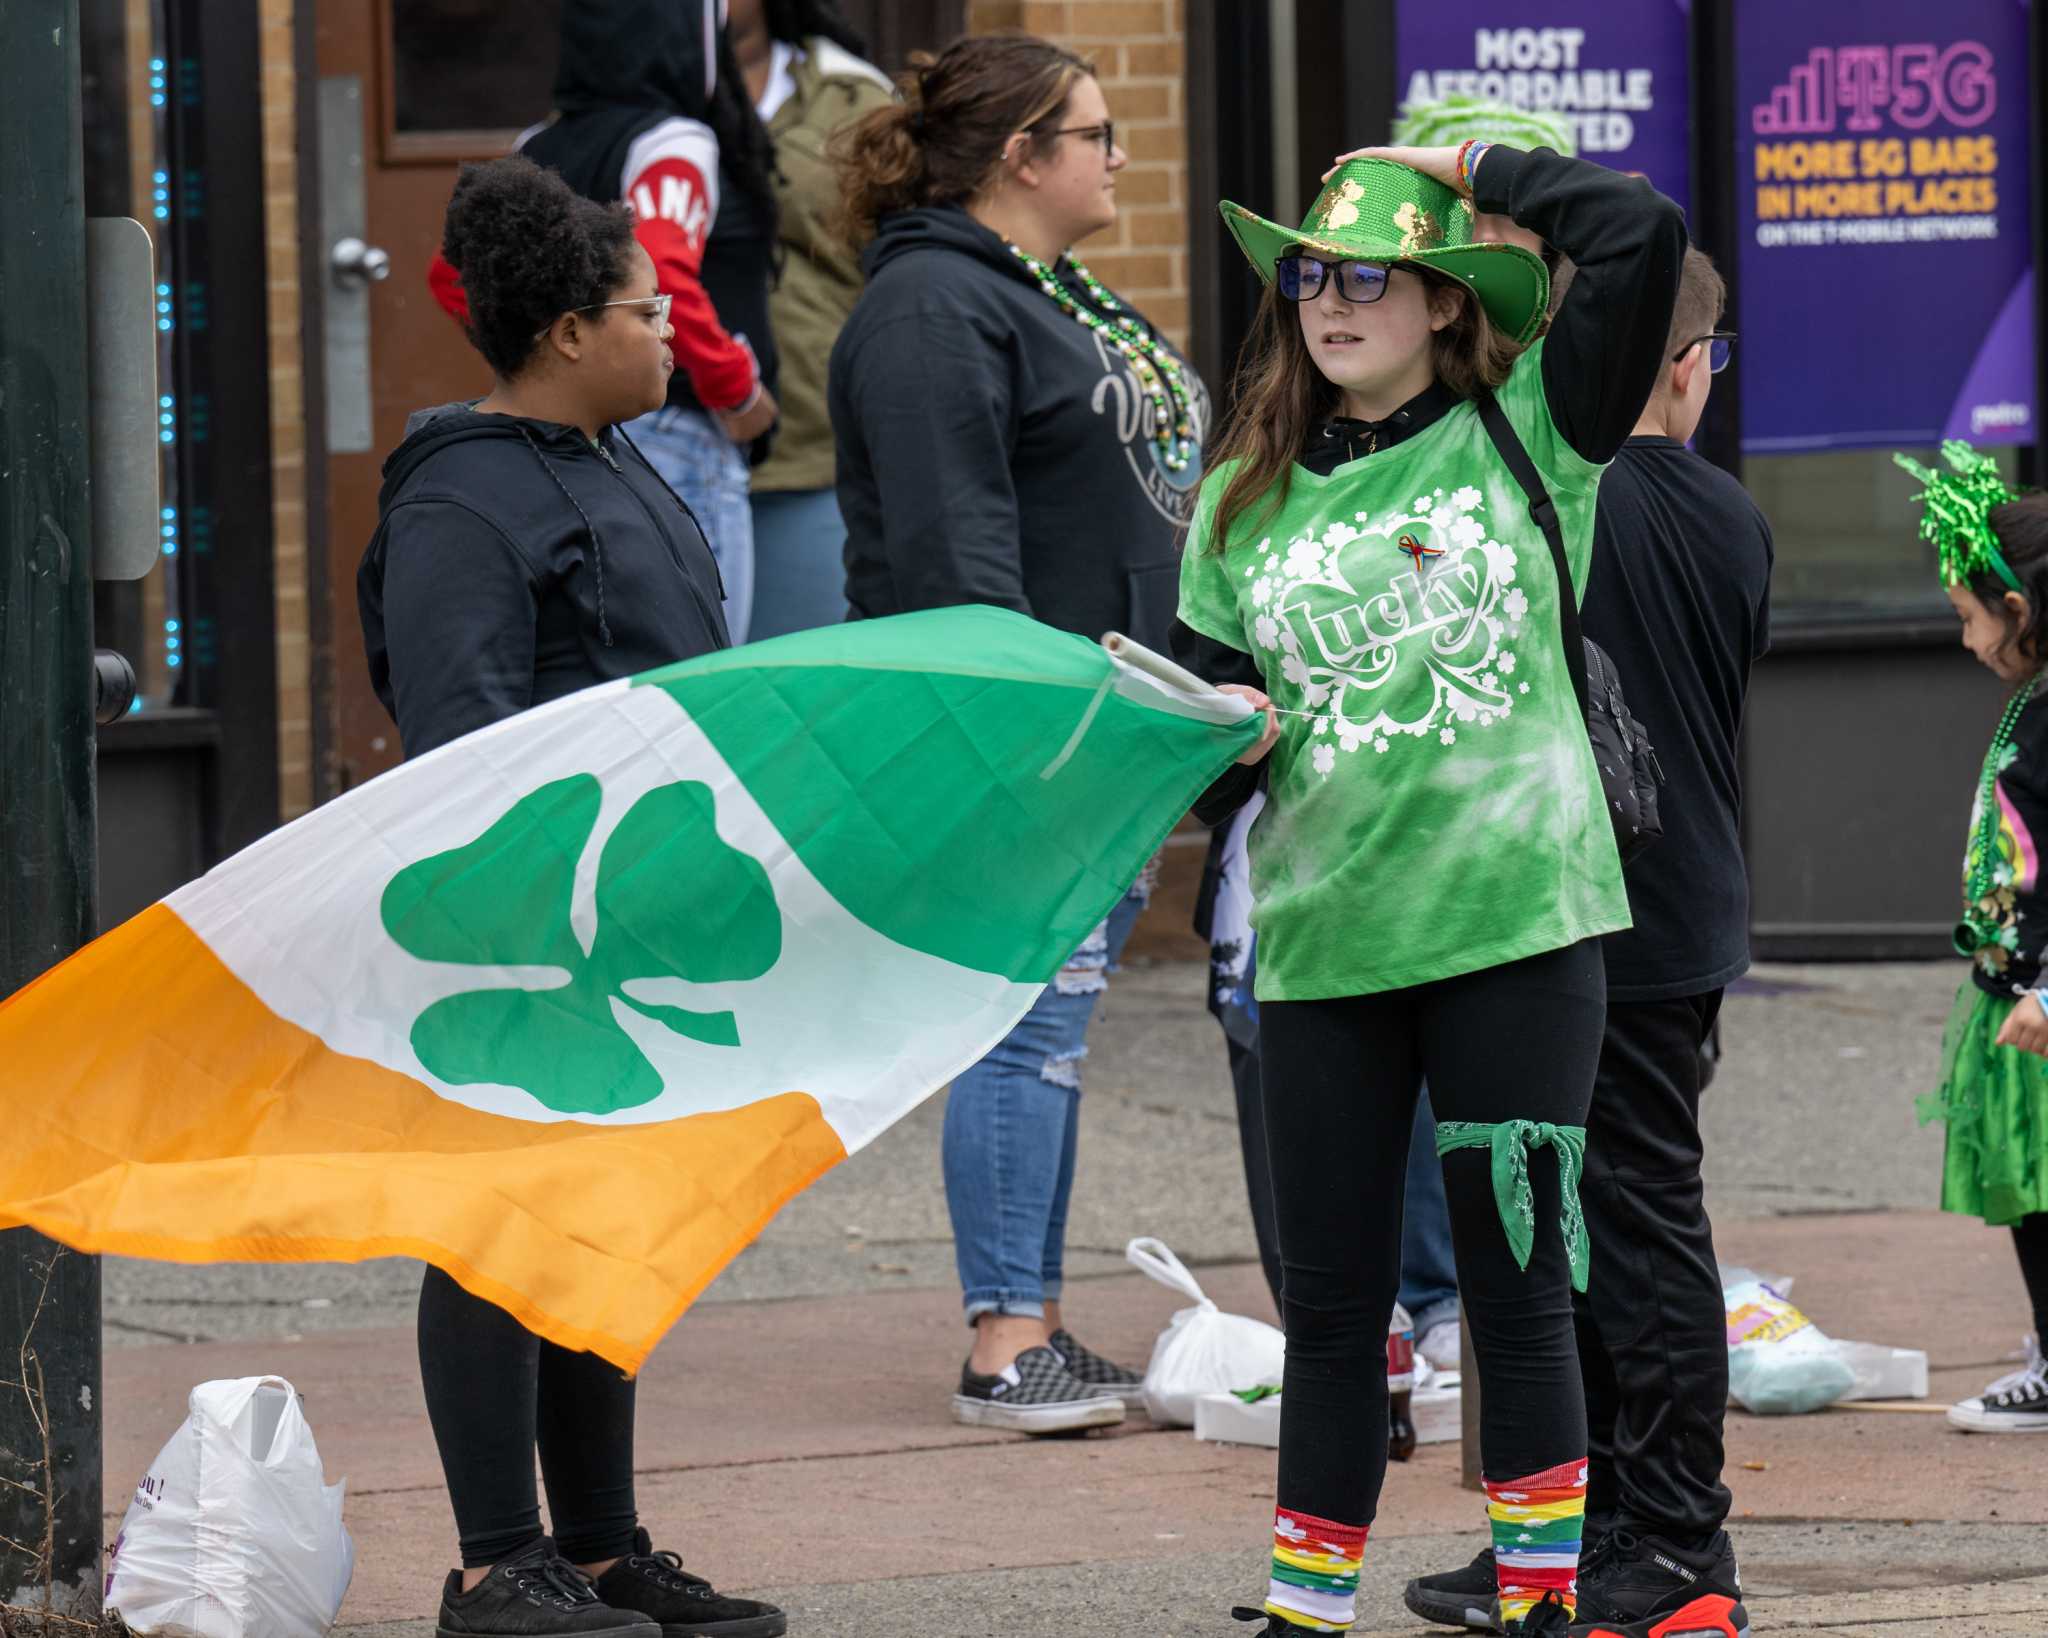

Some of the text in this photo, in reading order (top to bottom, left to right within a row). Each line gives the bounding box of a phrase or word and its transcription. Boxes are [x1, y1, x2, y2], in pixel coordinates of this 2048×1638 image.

[1474, 28, 1584, 70] MOST
[1405, 70, 1653, 110] AFFORDABLE
[1755, 139, 1856, 181] MORE
[1909, 134, 1998, 176] BARS
[1756, 177, 1998, 220] IN MORE PLACES
